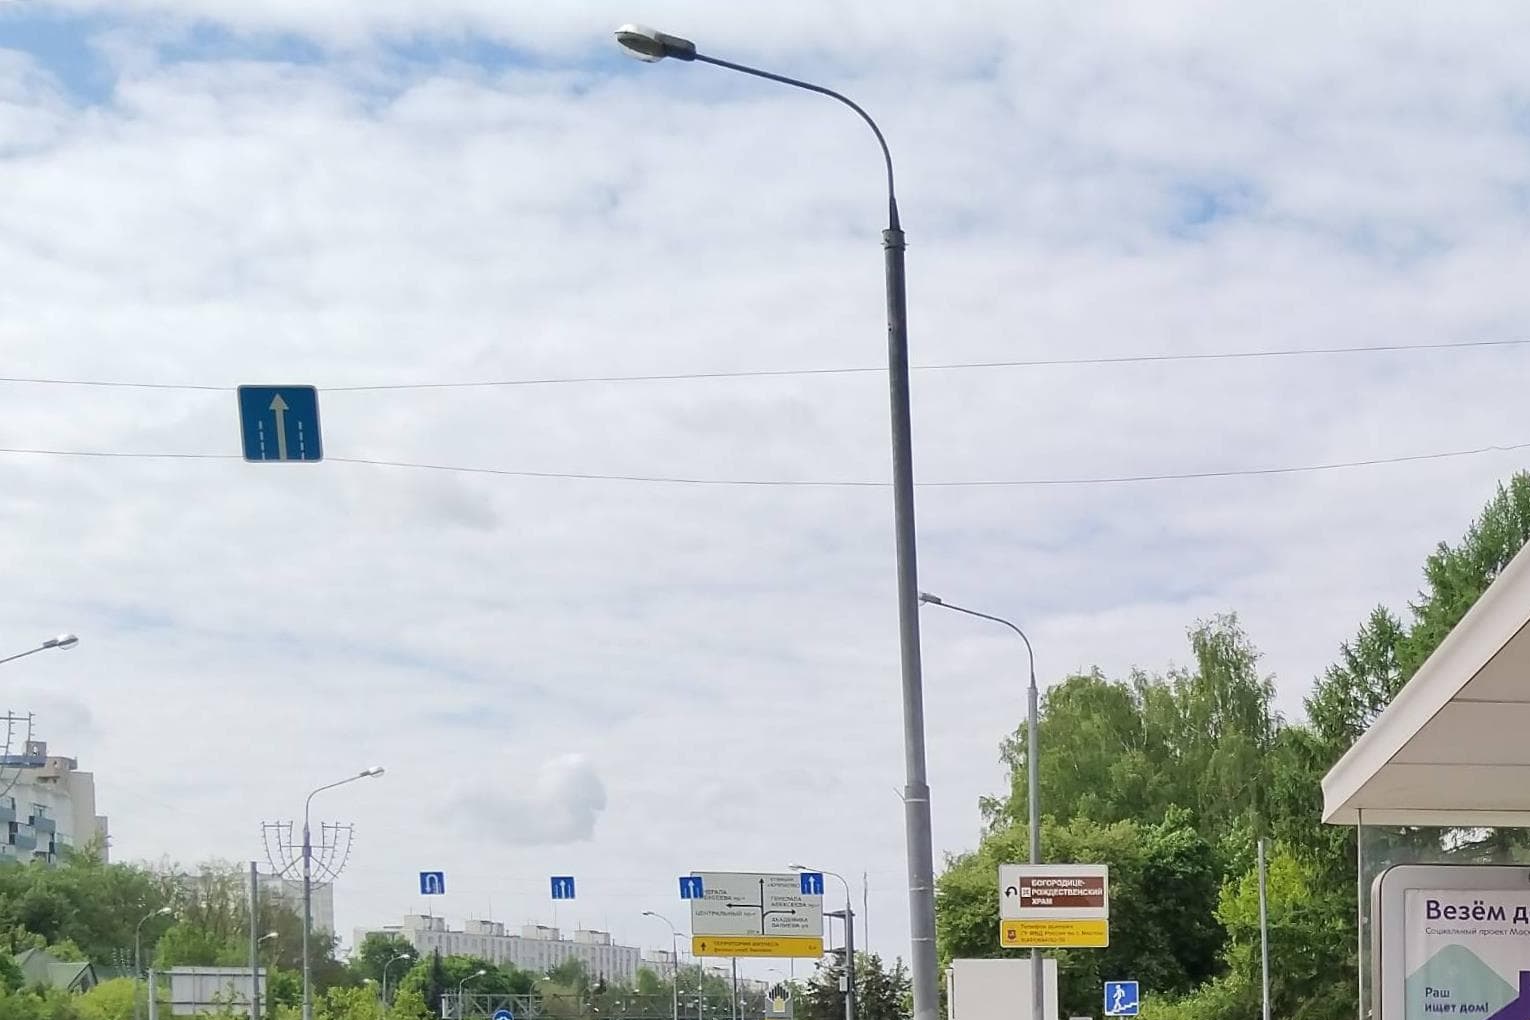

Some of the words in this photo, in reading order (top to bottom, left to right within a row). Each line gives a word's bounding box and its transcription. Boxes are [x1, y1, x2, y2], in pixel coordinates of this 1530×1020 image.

[1031, 887, 1103, 896] РОЖДЕСТВЕНСКИЙ
[1031, 897, 1053, 905] ХРАМ
[1425, 899, 1507, 921] Везём
[1425, 927, 1477, 936] Социальный
[1479, 928, 1507, 937] проект
[1425, 986, 1450, 998] Раш
[1424, 1003, 1457, 1014] ищет
[1460, 1002, 1489, 1014] дом!
